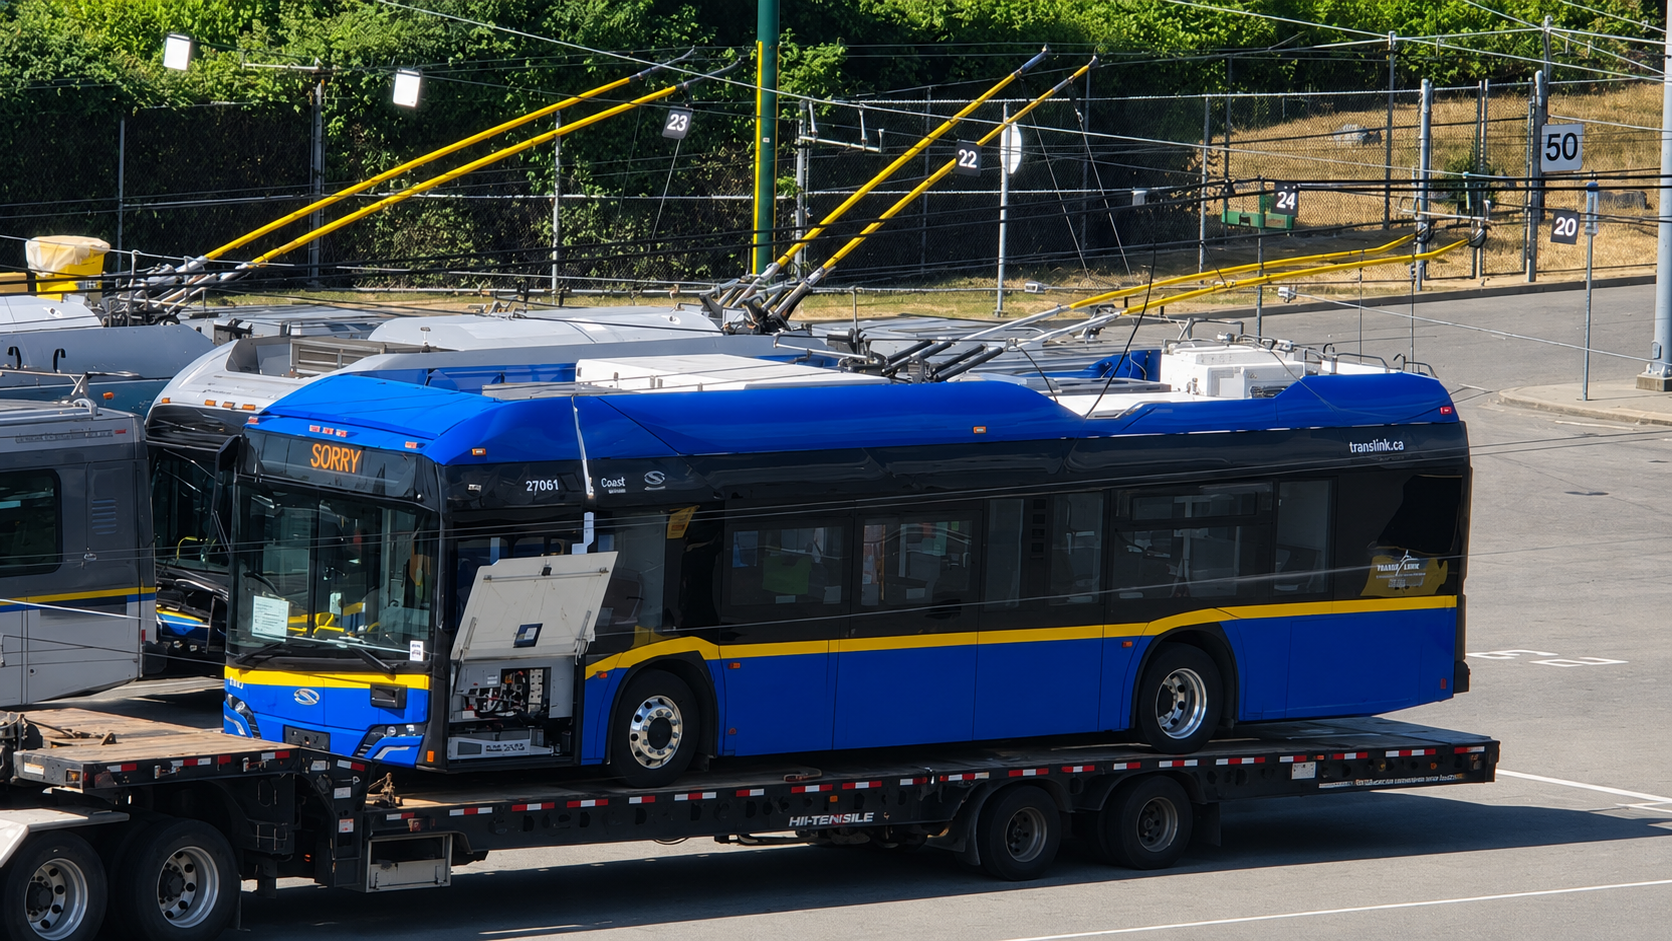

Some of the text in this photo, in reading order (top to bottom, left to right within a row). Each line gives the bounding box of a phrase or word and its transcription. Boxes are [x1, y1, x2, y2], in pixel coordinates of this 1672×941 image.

[666, 113, 688, 131] 23
[1545, 132, 1578, 161] 50
[958, 149, 977, 169] 22
[1276, 191, 1296, 210] 24
[1553, 216, 1577, 236] 20
[1349, 438, 1405, 453] translink.ca
[310, 443, 362, 473] SORRY
[526, 479, 559, 492] 27061
[601, 476, 626, 488] Coast
